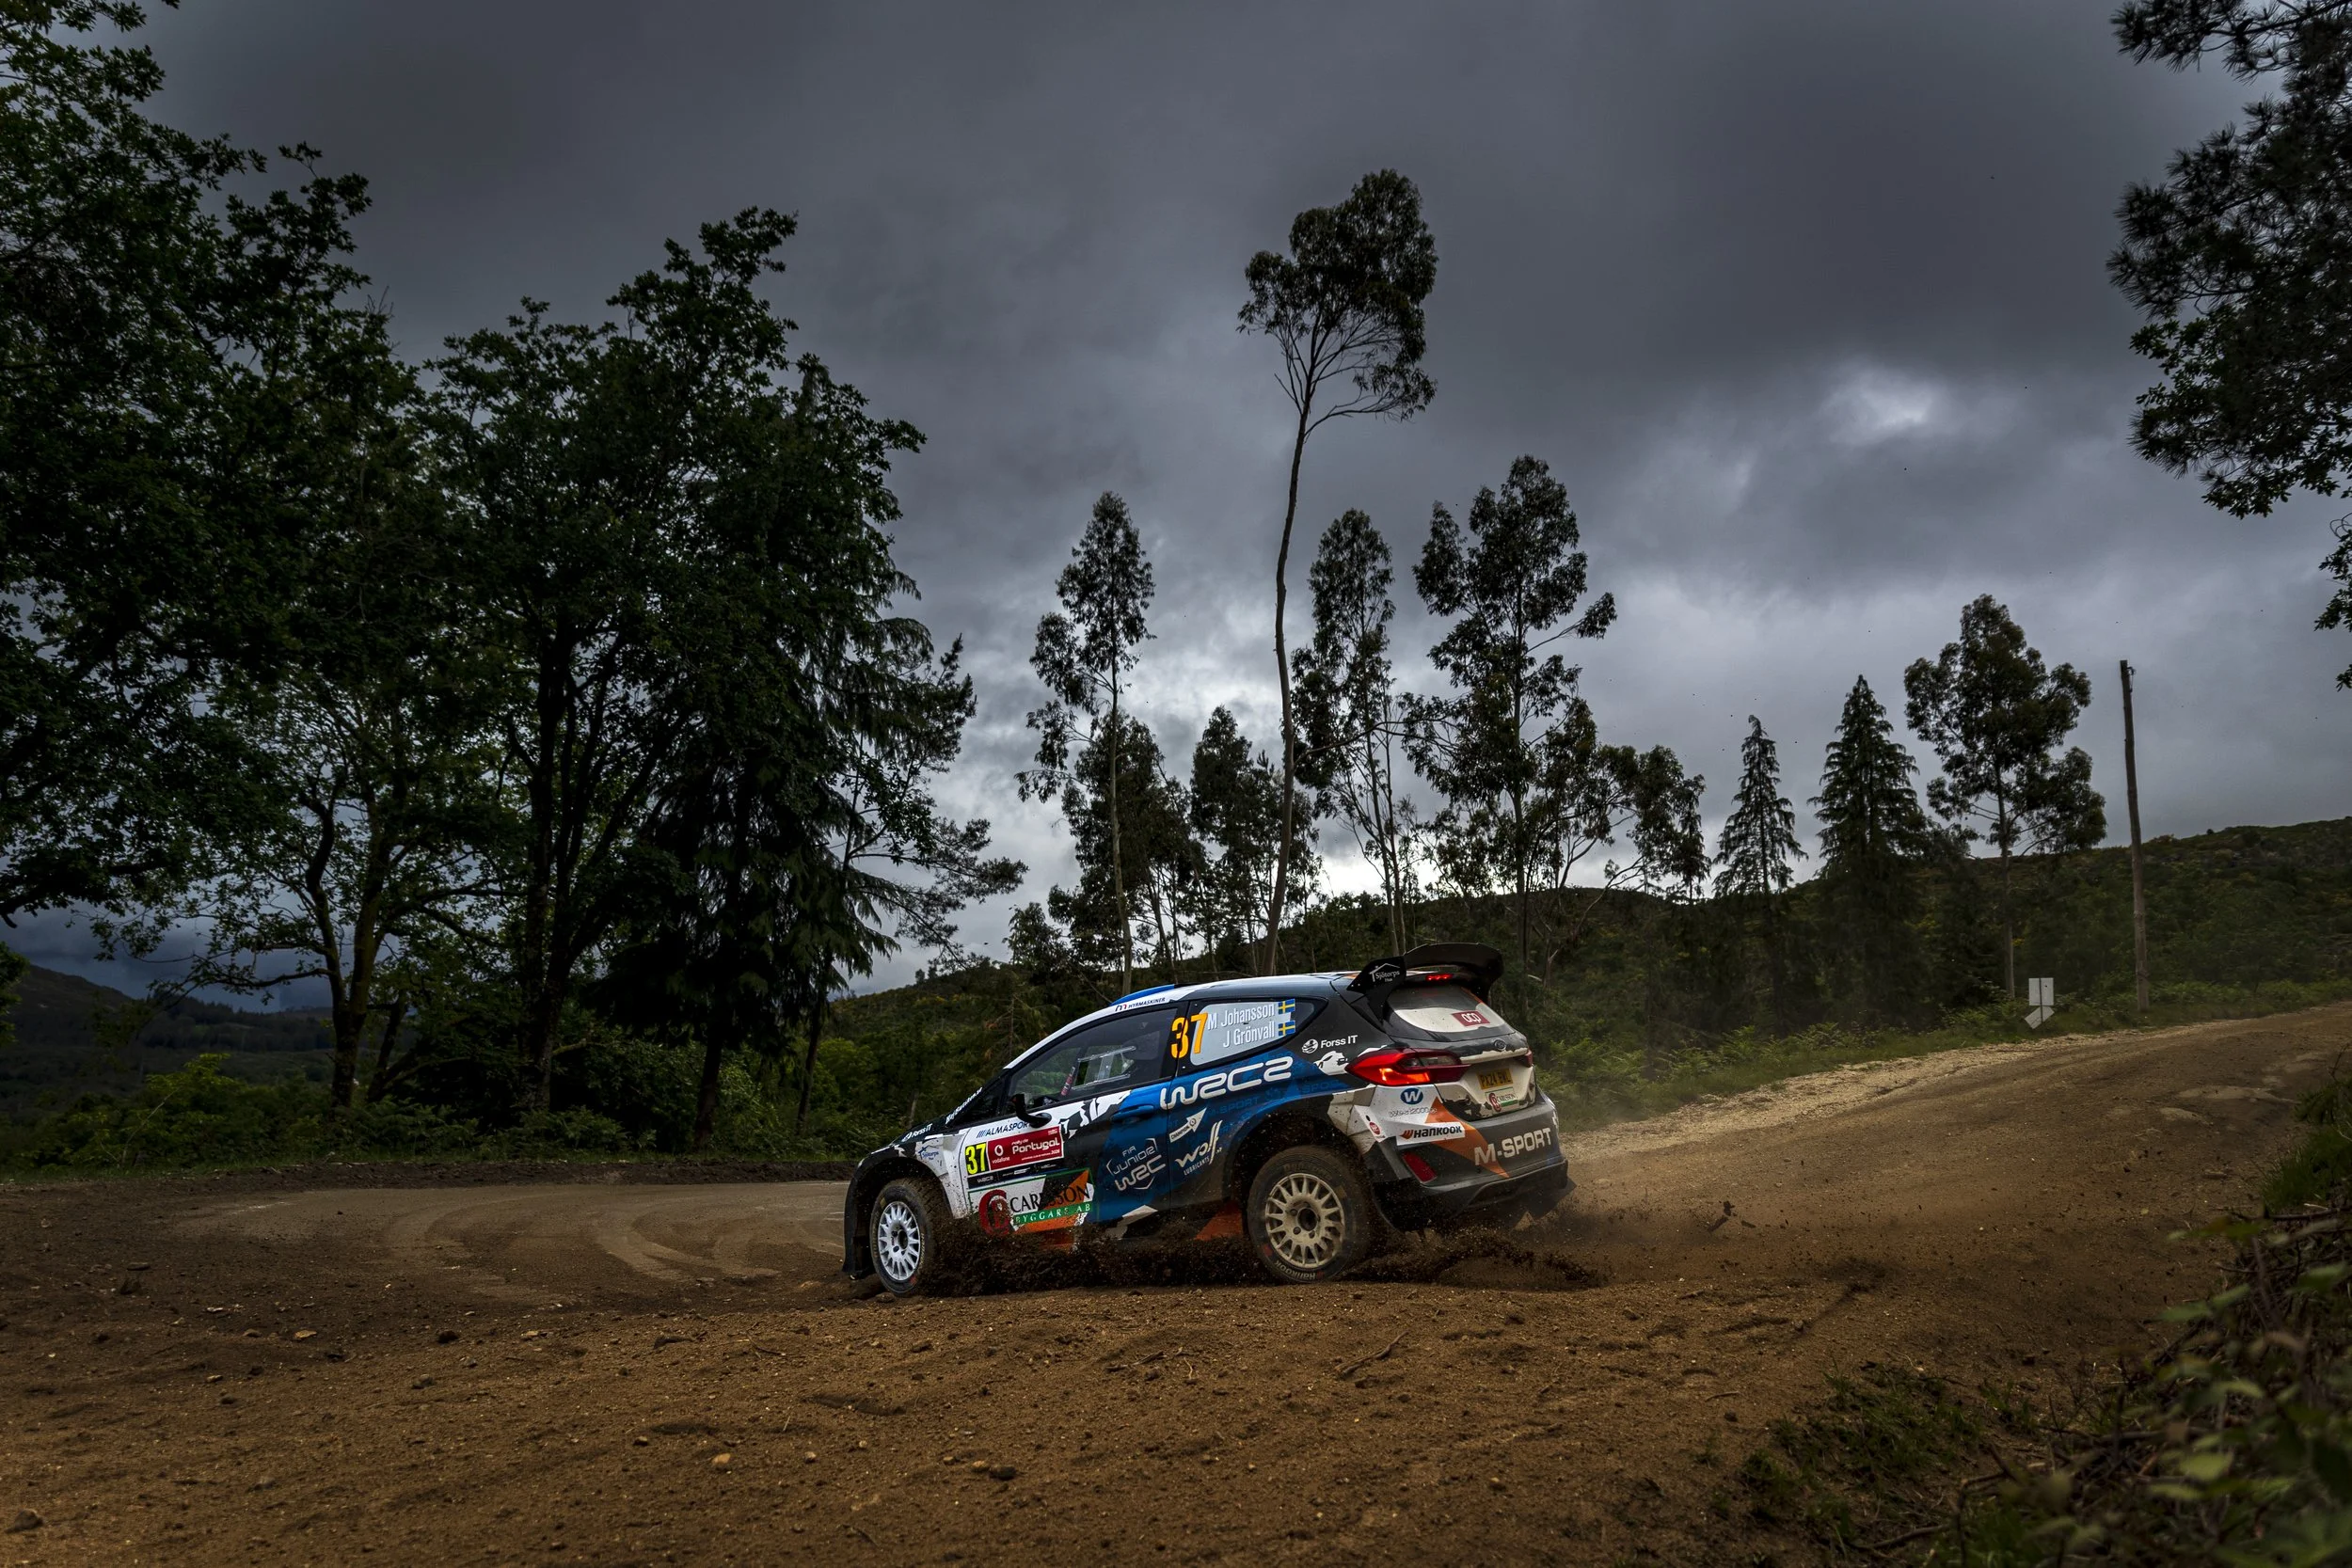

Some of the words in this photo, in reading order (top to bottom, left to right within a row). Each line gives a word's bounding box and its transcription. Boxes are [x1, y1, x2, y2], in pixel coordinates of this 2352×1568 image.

[1208, 1014, 1217, 1030] M
[1222, 1003, 1275, 1027] Johansson
[1170, 1013, 1208, 1059] 37
[1223, 1031, 1231, 1048] J
[1234, 1021, 1275, 1046] Grönvall
[1320, 1038, 1346, 1049] Forss
[1347, 1035, 1358, 1044] IT
[1160, 1056, 1294, 1110] WRC2
[1012, 1137, 1060, 1154] Portugal
[1122, 1146, 1136, 1157] FIA
[1474, 1128, 1551, 1165] M-SPORT
[965, 1144, 986, 1175] 37
[992, 1156, 1010, 1164] vodafone
[1113, 1146, 1156, 1175] JUNIOR
[1115, 1154, 1166, 1191] WRC
[1184, 1156, 1210, 1176] LUBRICANTS
